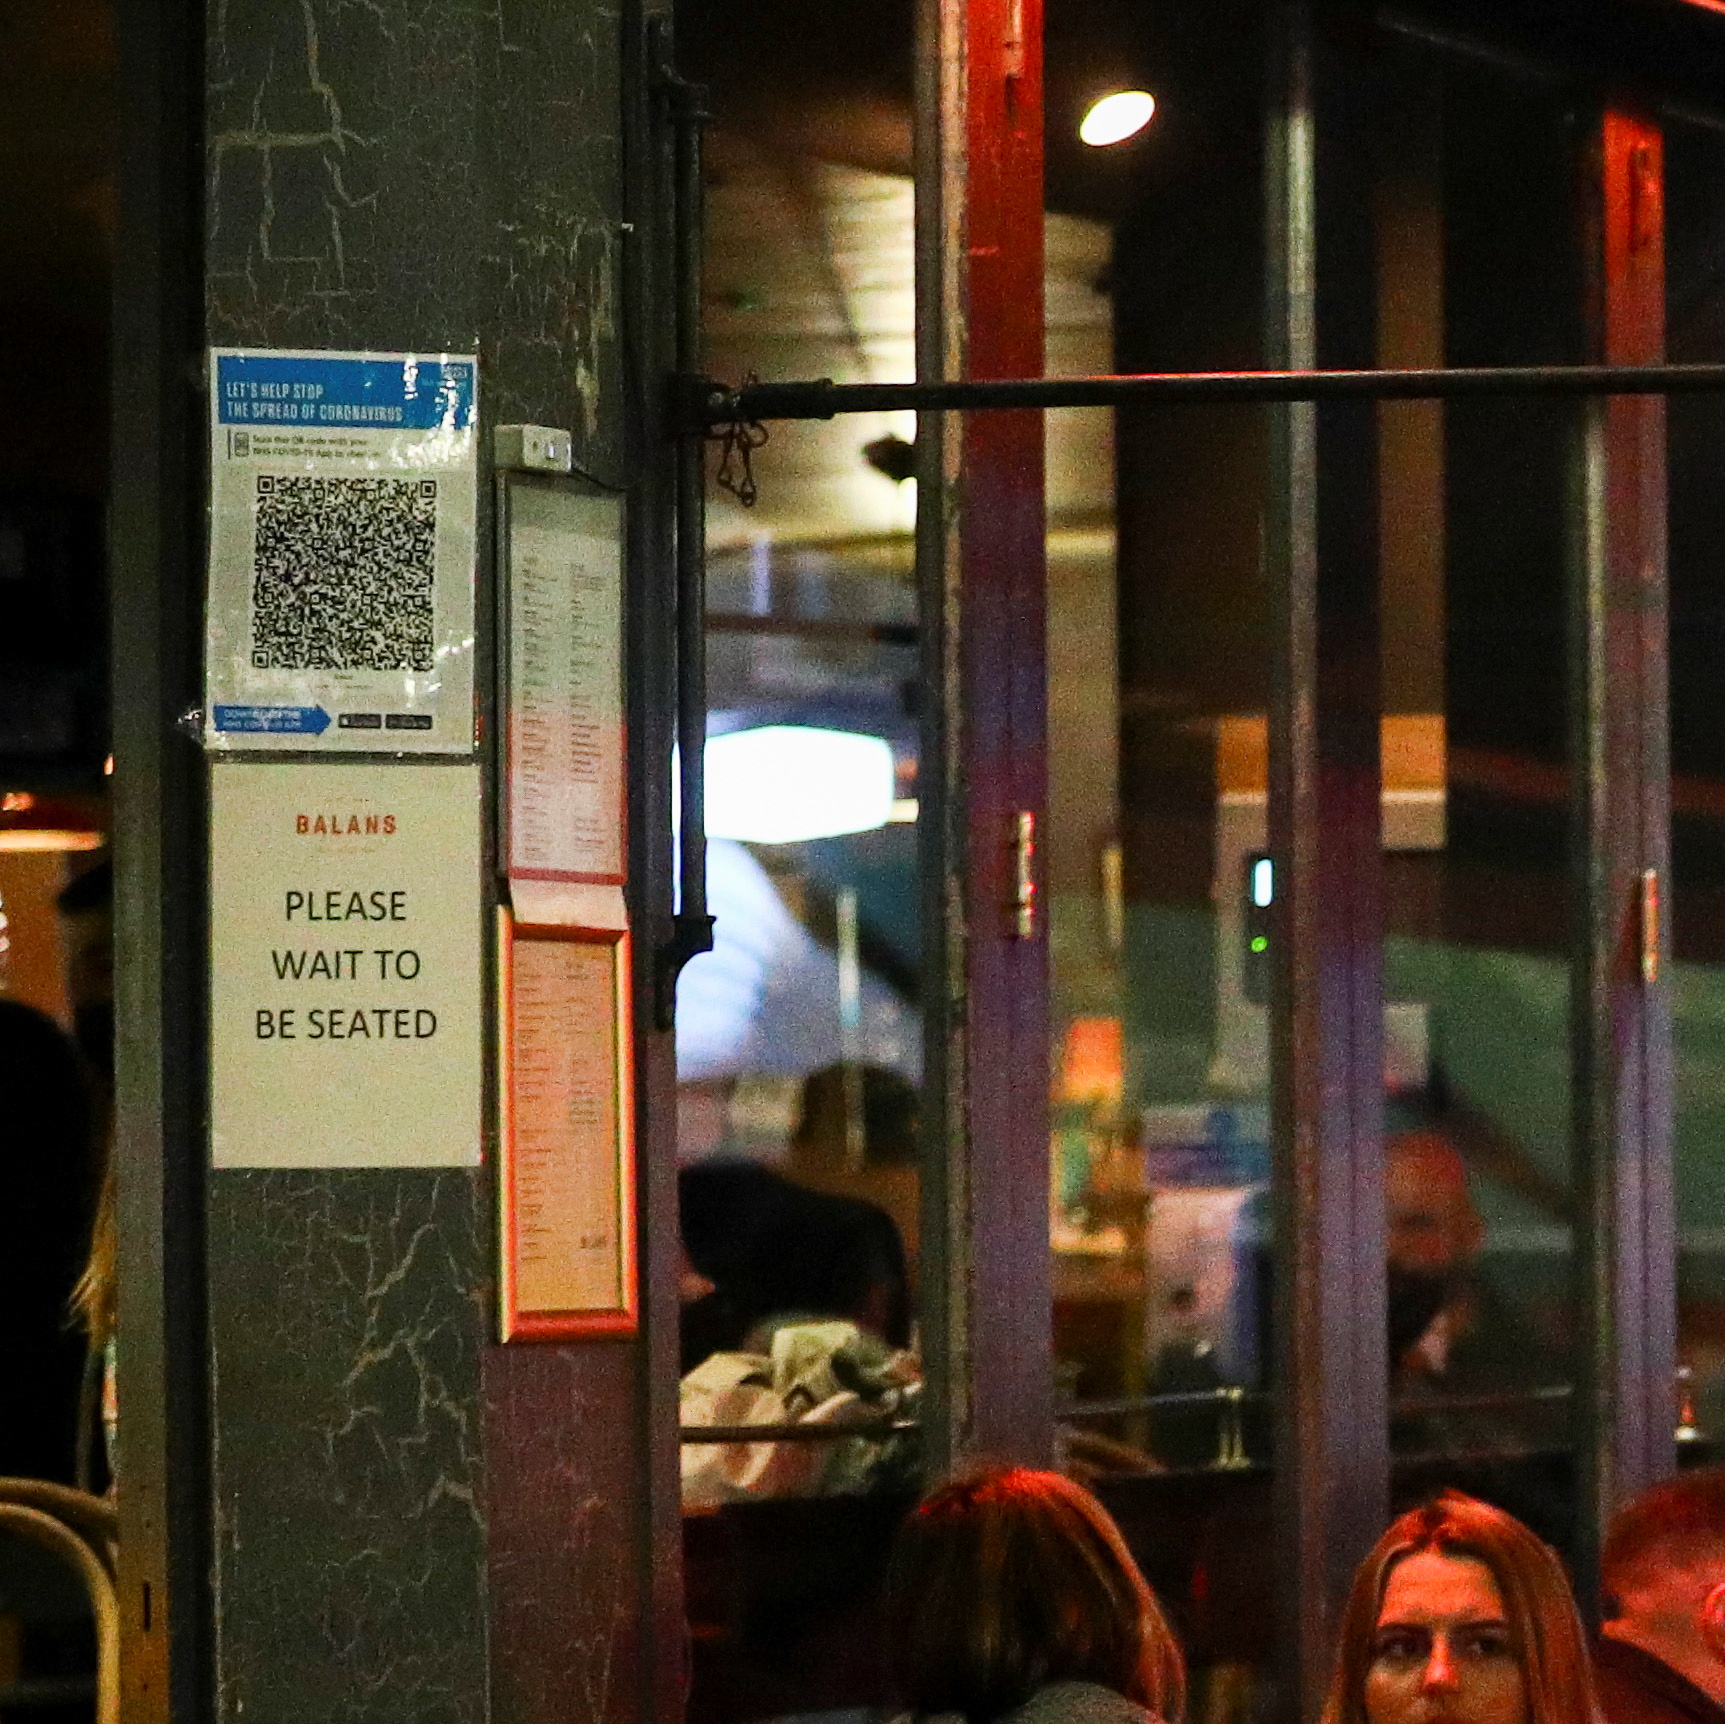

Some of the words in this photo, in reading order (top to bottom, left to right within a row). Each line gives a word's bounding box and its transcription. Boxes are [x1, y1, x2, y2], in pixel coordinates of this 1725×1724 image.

[226, 382, 257, 400] LET'S
[261, 383, 289, 400] HELP
[293, 383, 324, 401] STOP
[227, 401, 249, 418] THE
[252, 402, 298, 420] SPREAD
[301, 403, 315, 420] OF
[319, 404, 403, 422] CORONAVIRUS
[295, 814, 397, 835] BALANS
[285, 890, 407, 921] PLEASE
[271, 949, 364, 980] WAIT
[374, 949, 421, 980] TO
[256, 1009, 296, 1039] BE
[308, 1008, 437, 1039] SEATED
